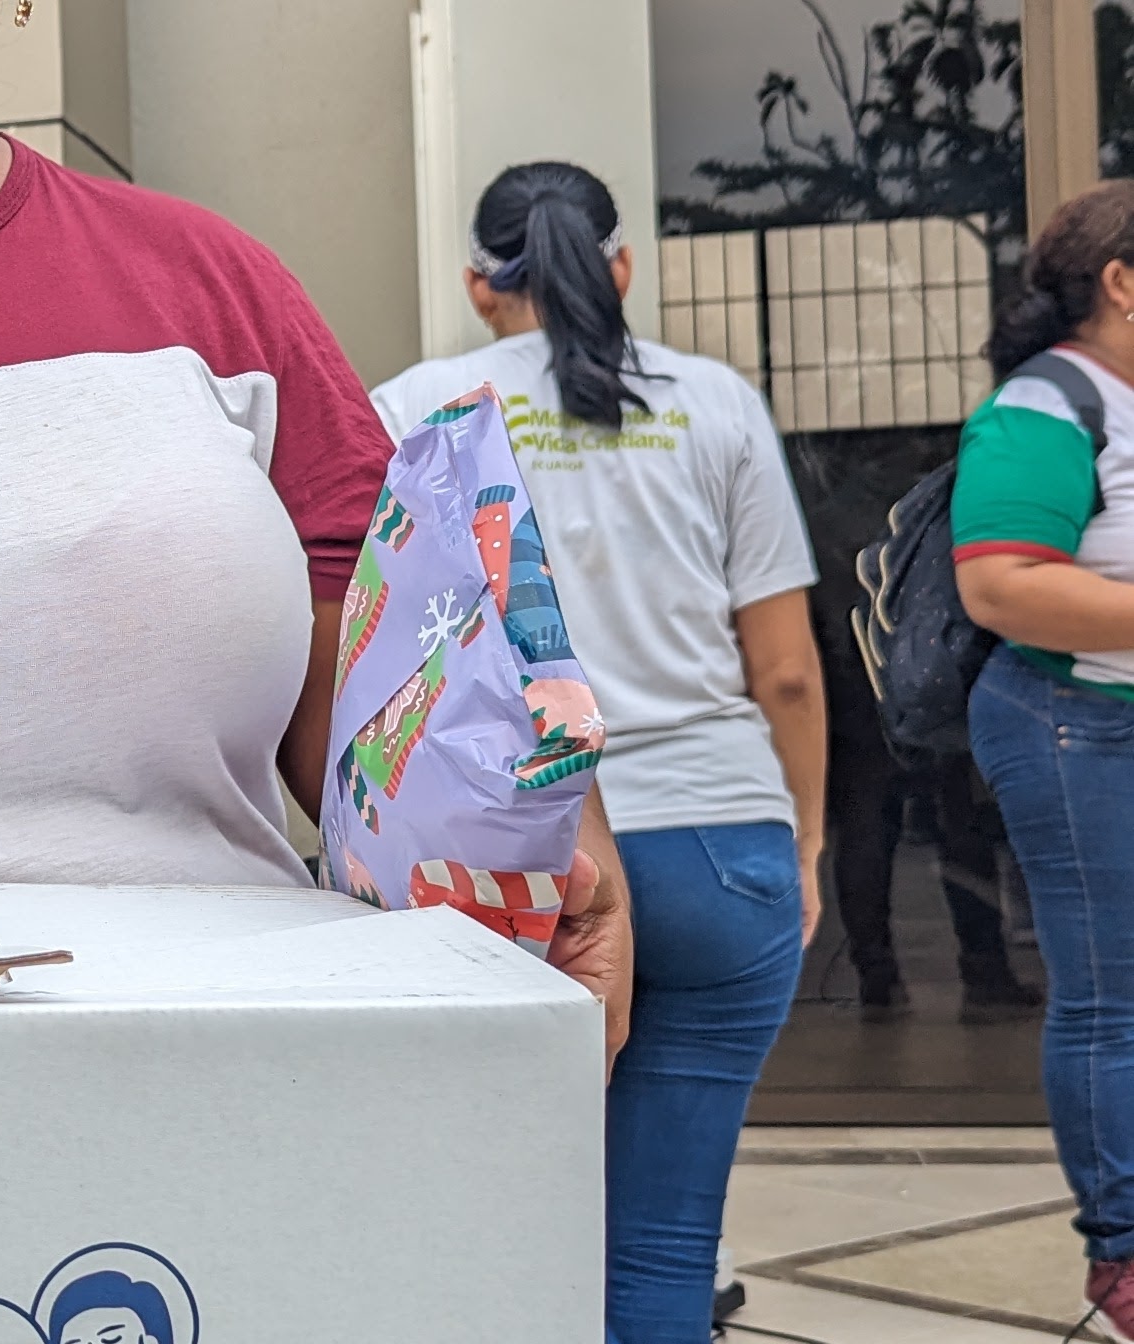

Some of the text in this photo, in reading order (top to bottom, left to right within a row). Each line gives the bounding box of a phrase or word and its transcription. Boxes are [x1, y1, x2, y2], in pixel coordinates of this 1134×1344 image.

[662, 409, 690, 429] de
[531, 429, 676, 454] Vida Cristiana
